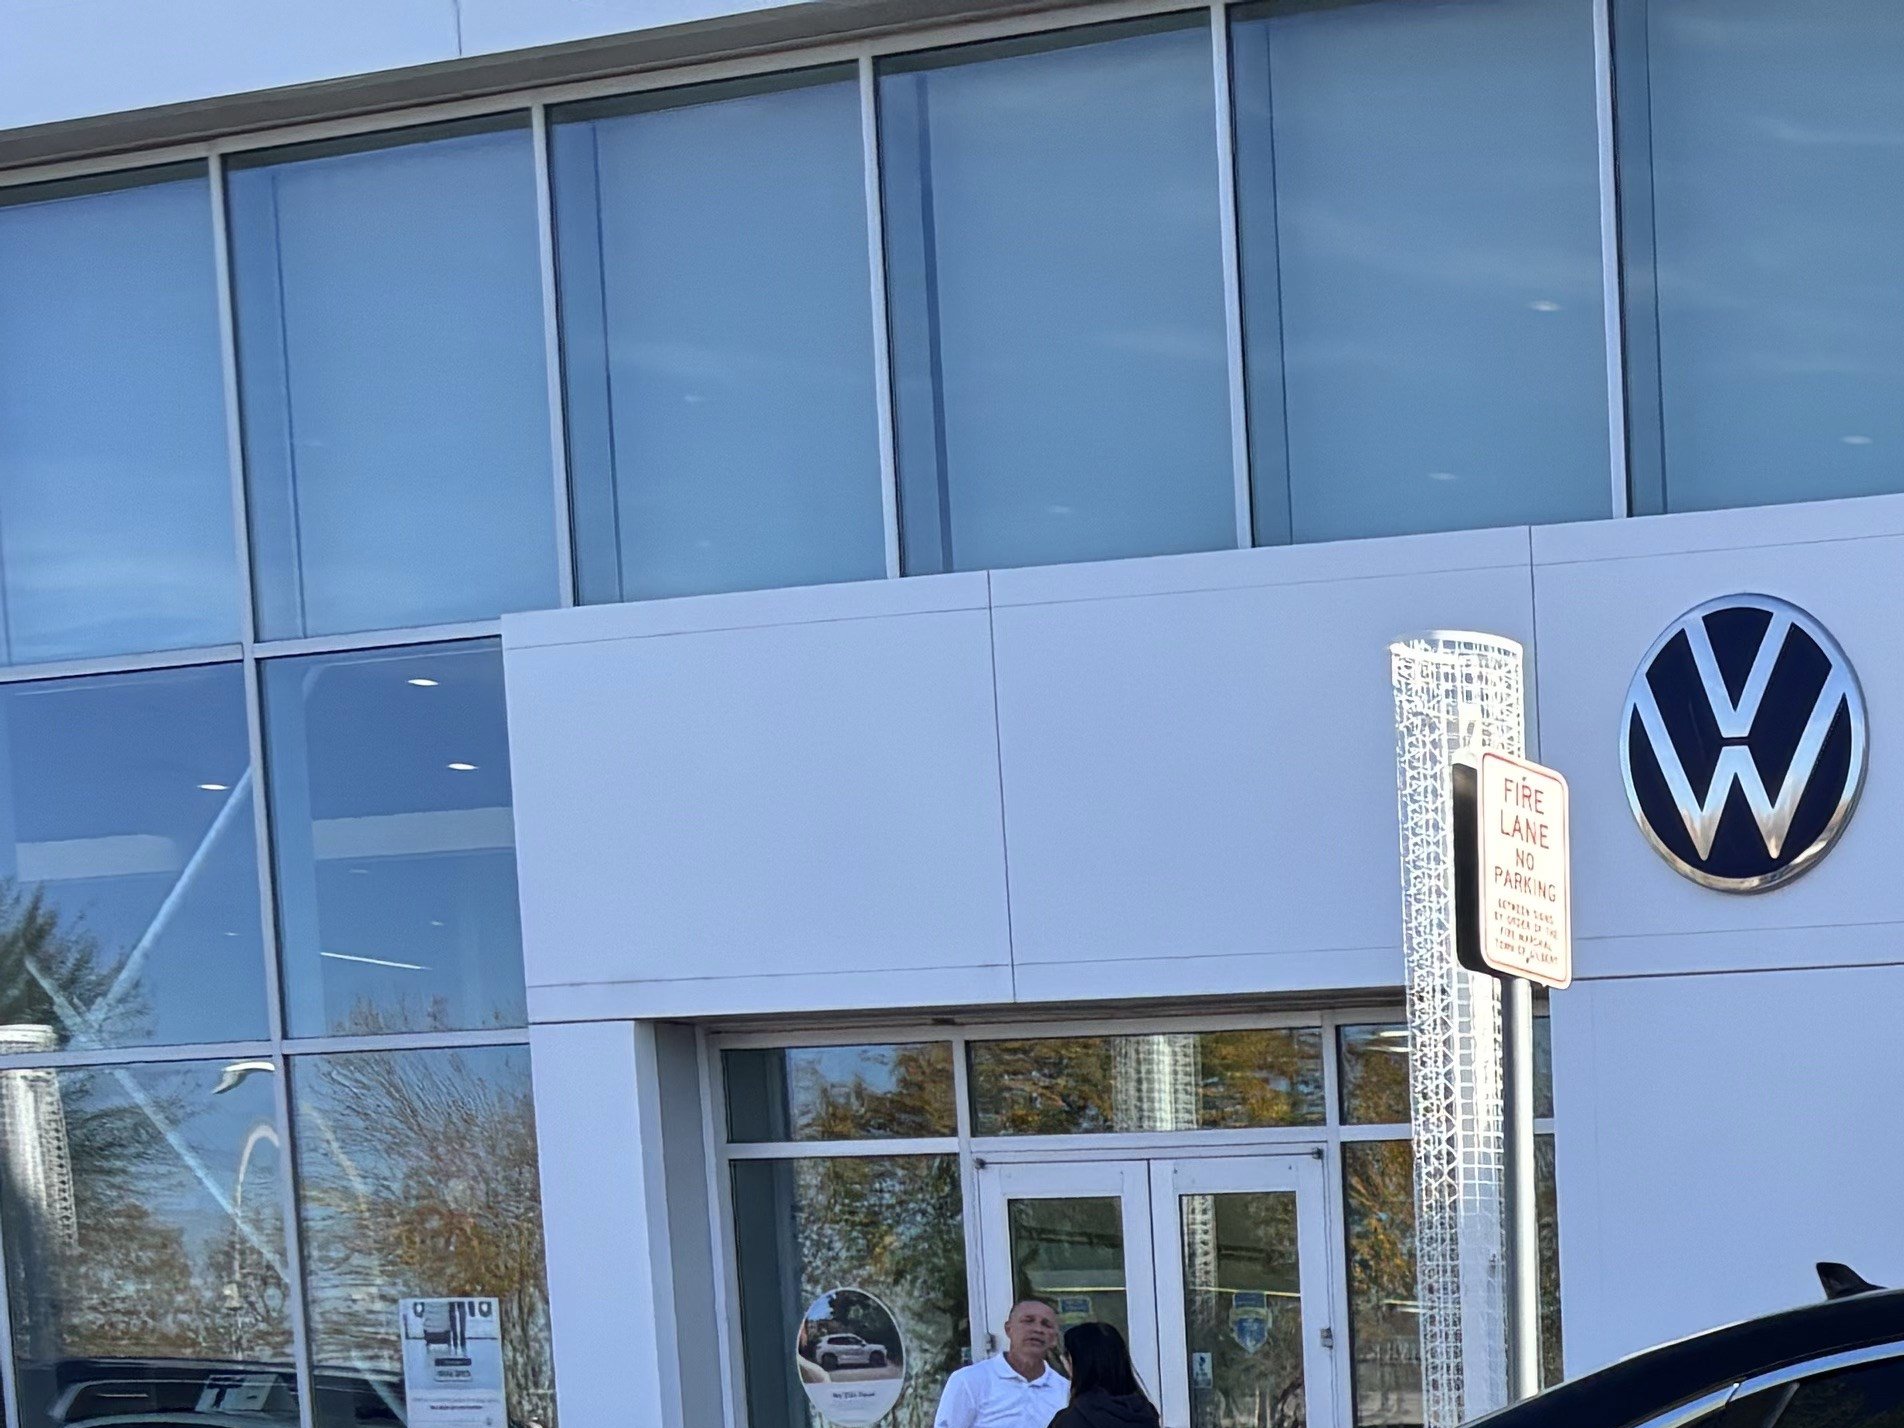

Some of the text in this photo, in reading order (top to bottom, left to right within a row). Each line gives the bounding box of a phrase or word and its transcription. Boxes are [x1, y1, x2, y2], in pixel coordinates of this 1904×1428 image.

[1625, 598, 1863, 882] VW
[1504, 777, 1544, 815] FIRE
[1500, 808, 1549, 849] LANE
[1515, 848, 1534, 871] NO
[1494, 865, 1556, 902] PARKING
